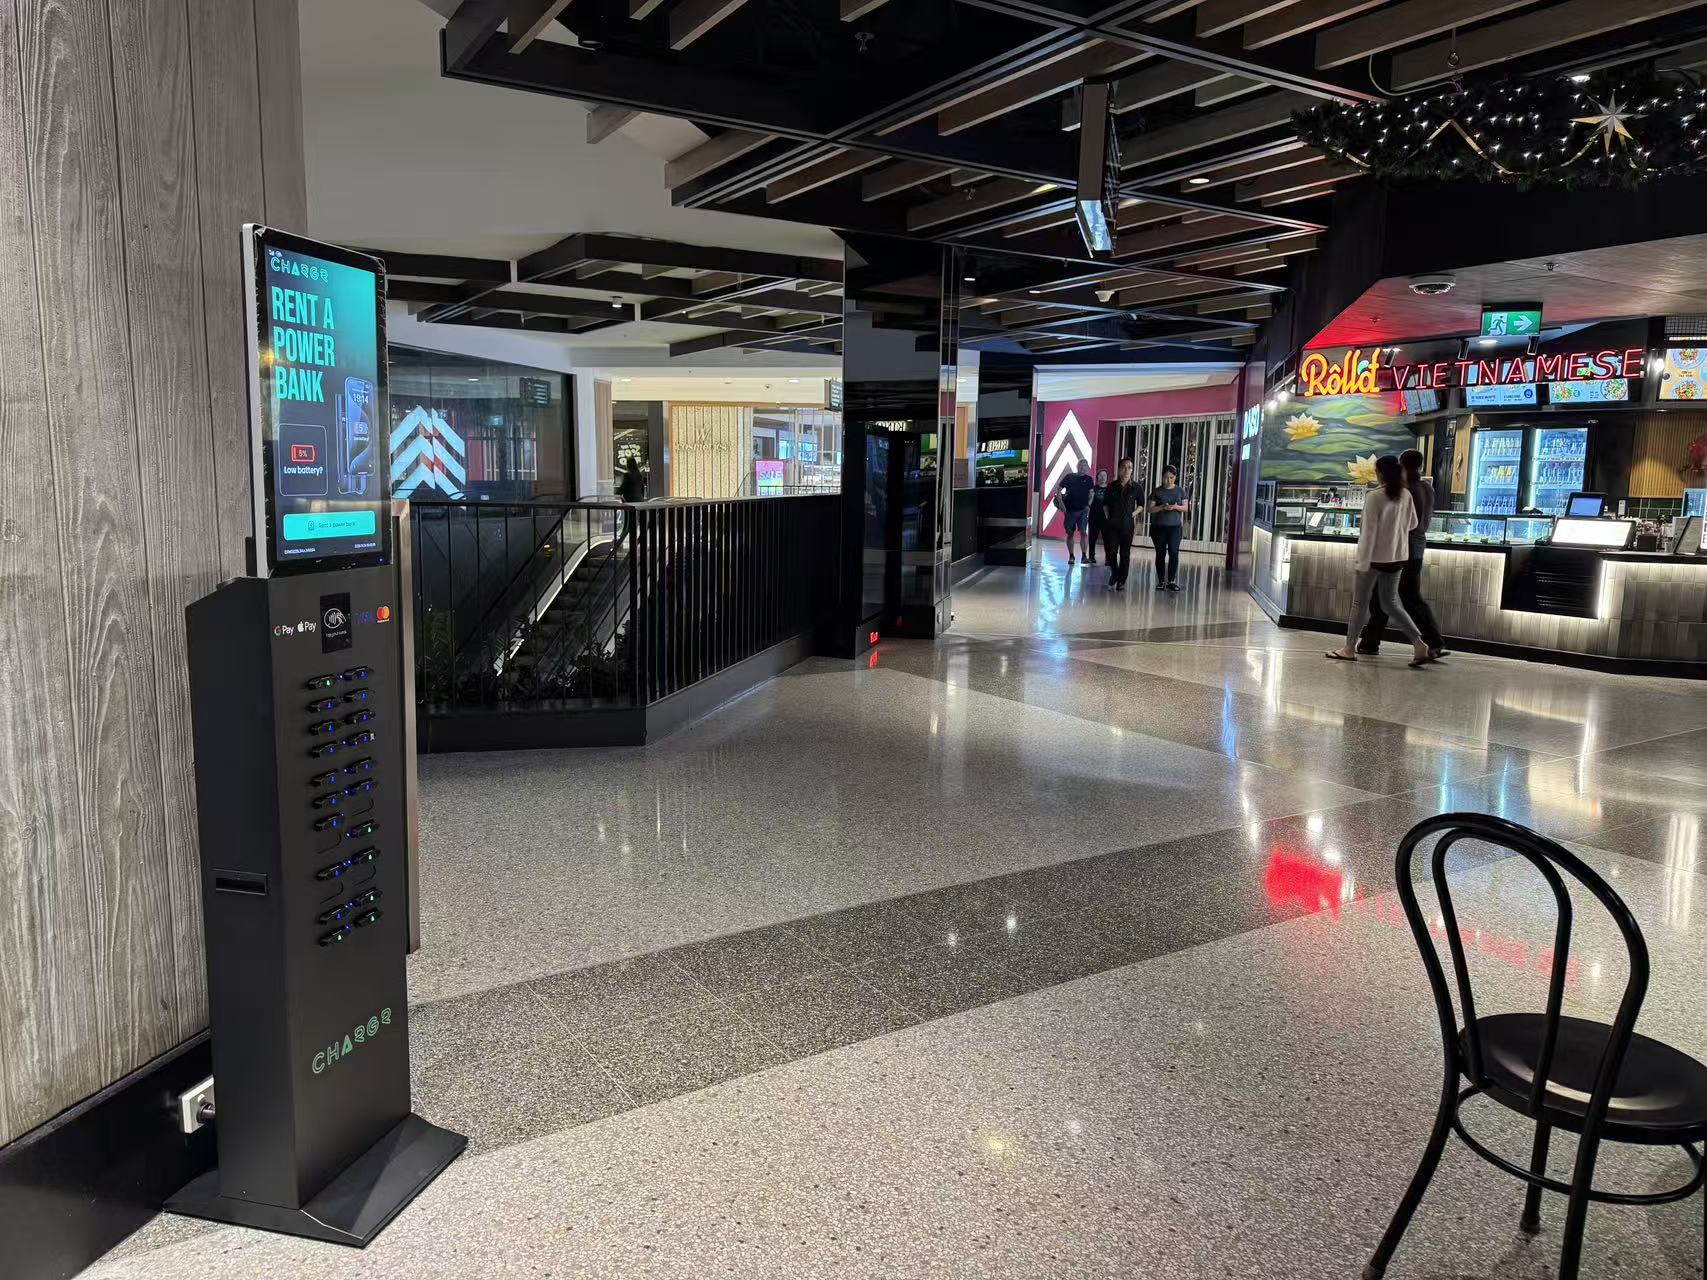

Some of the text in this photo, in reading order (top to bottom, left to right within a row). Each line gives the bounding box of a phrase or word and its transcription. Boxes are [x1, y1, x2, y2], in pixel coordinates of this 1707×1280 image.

[272, 286, 335, 329] RENT A
[273, 326, 336, 367] POWER
[1392, 348, 1643, 390] VIETNAMESE
[275, 366, 324, 403] BANK
[298, 449, 308, 458] 5%
[283, 465, 324, 476] Low battery?
[282, 625, 295, 636] Pay
[304, 621, 317, 633] Pay
